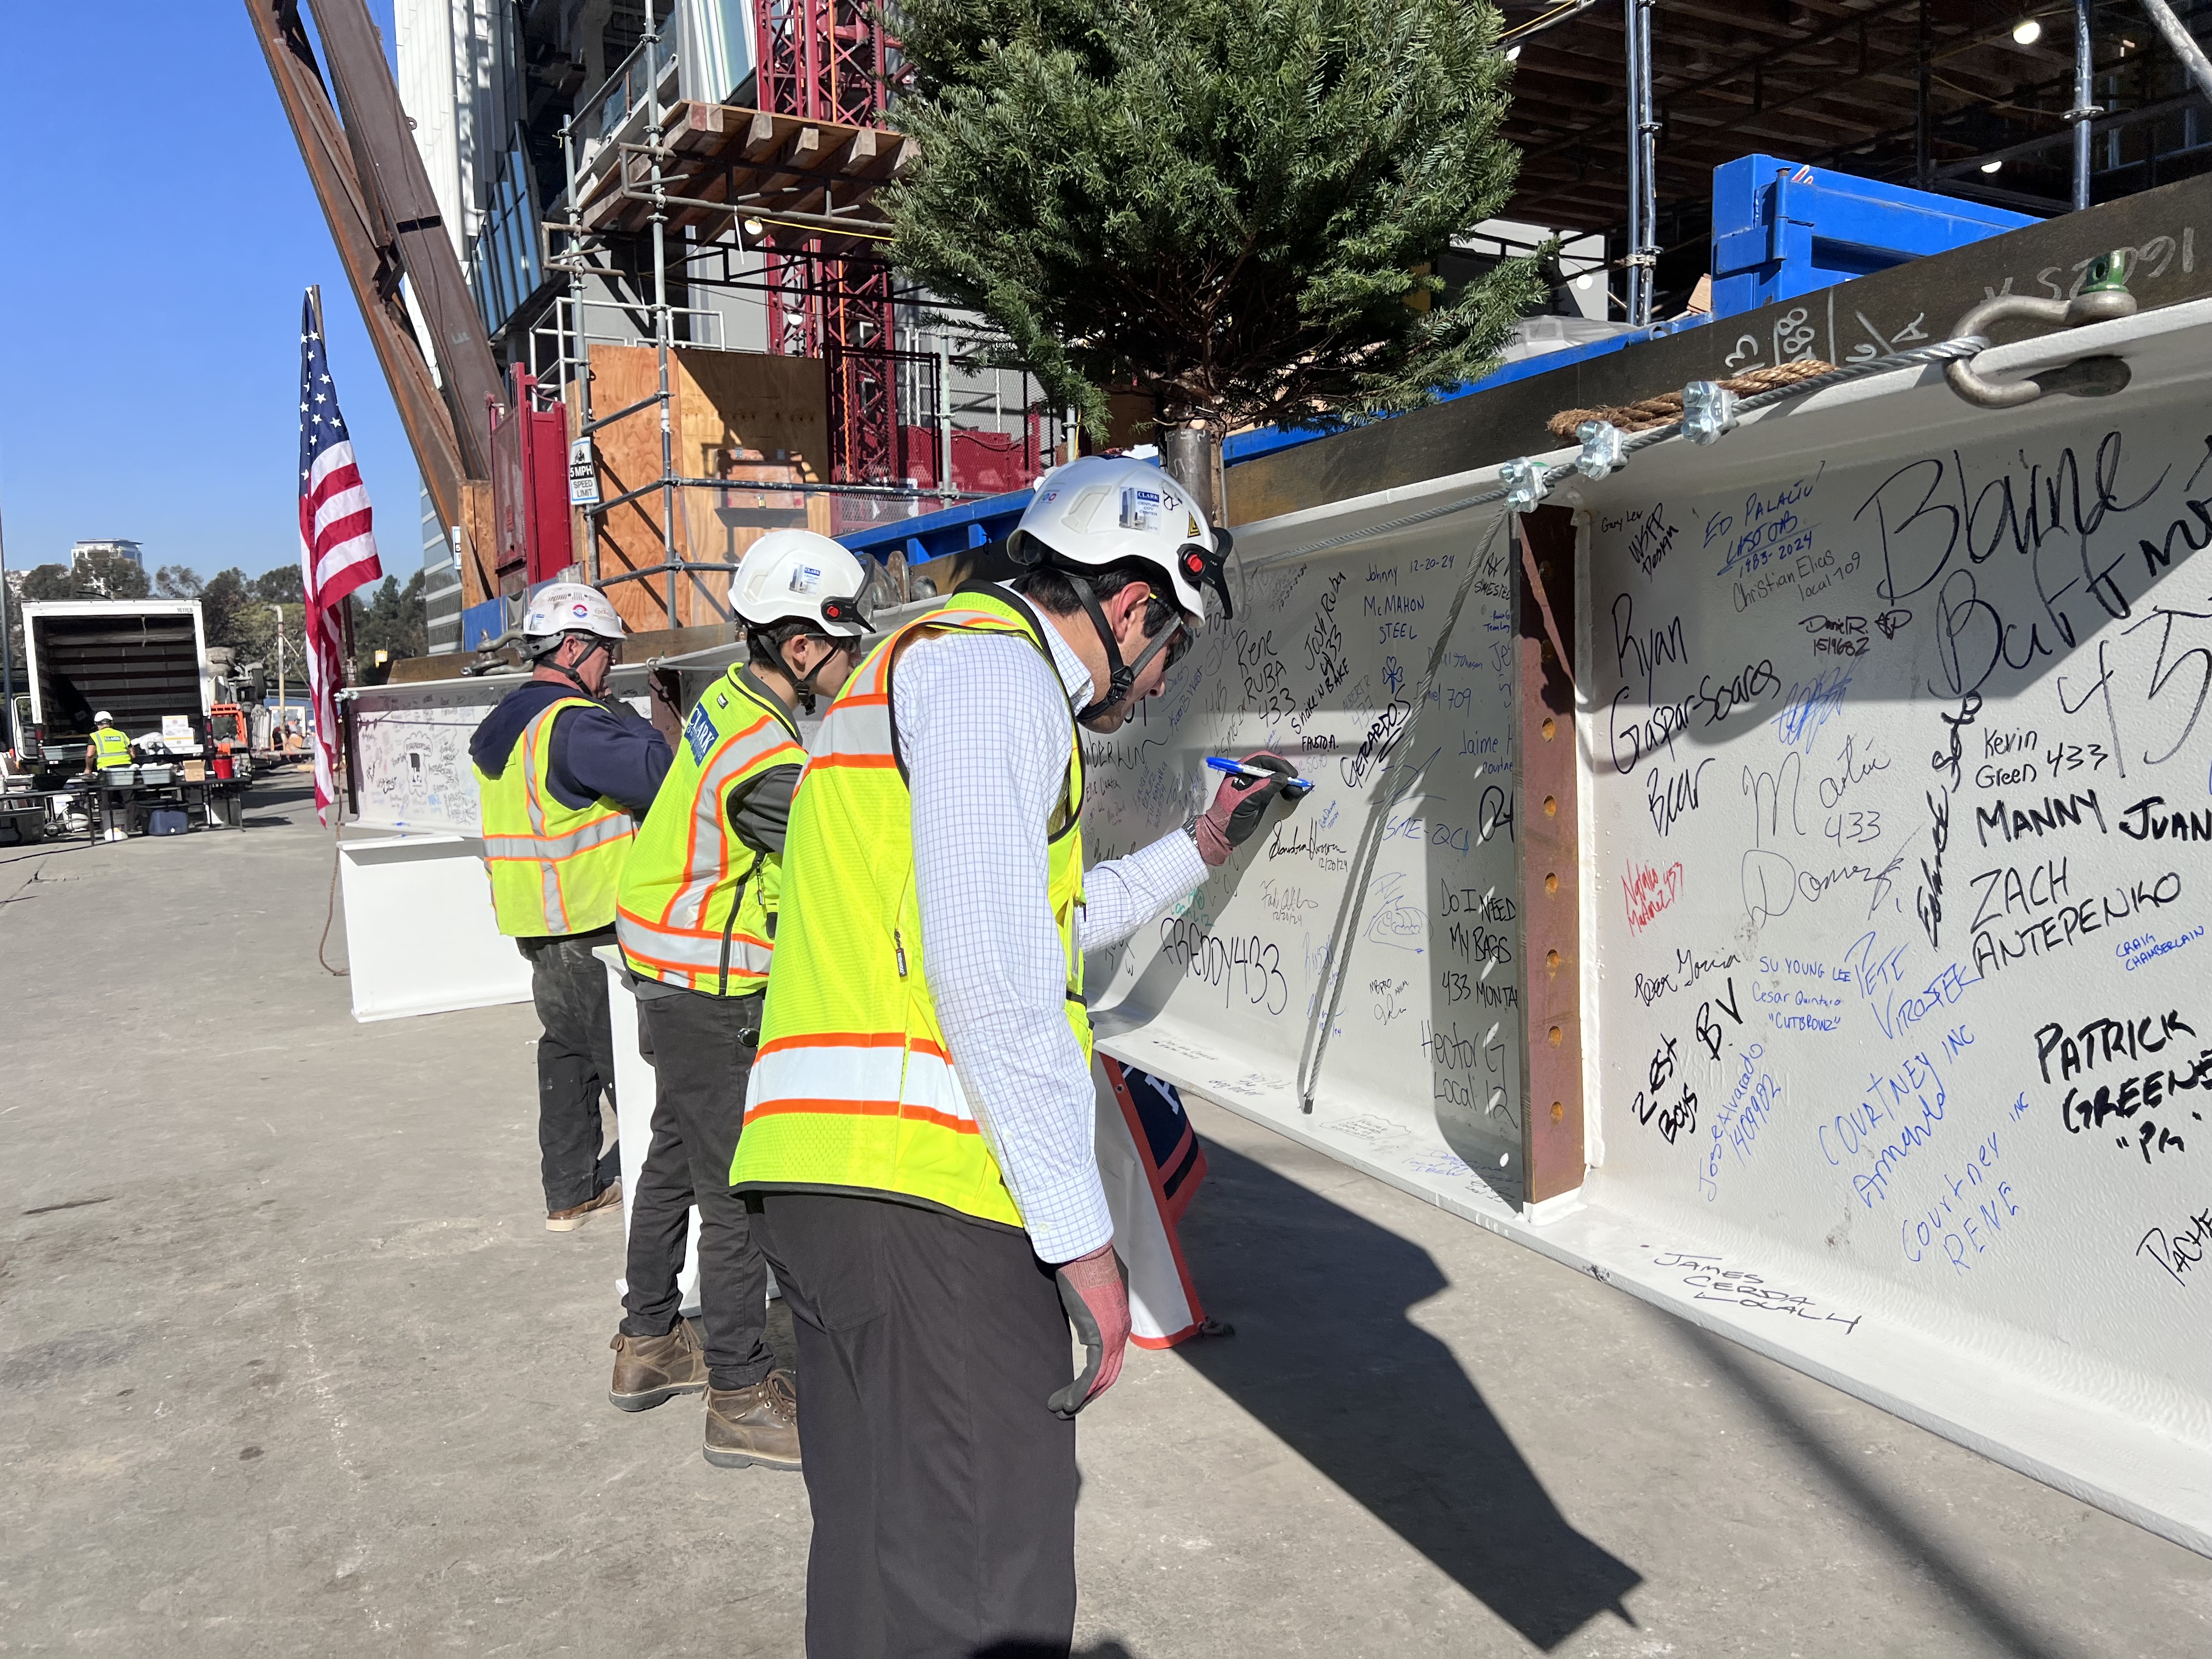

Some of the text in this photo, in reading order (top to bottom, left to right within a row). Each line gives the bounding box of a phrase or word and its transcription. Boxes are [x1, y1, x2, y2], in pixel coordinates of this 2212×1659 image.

[573, 480, 593, 488] SPEED
[577, 488, 592, 498] LIMIT
[1138, 492, 1159, 500] CLARK
[1365, 562, 1398, 586] Johnny
[1379, 622, 1418, 645] STEEL
[1611, 592, 1688, 709] Ryan
[1258, 687, 1296, 729] 433
[1447, 687, 1472, 718] 709
[689, 707, 715, 754] CLARK
[1459, 730, 1499, 756] Jaime
[1984, 727, 2038, 759] Kevin
[1976, 742, 2108, 789] Green 433
[1824, 810, 1881, 848] 433
[1977, 789, 2107, 848] MANNY
[1318, 857, 1348, 872] 12/20/24
[1460, 889, 1476, 913] I
[1479, 894, 1516, 923] NEED
[1970, 855, 2068, 934] ZACH
[1472, 926, 1511, 964] BAGS
[2124, 925, 2205, 971] CHAMBERLAIN
[1759, 956, 1779, 973] SU
[1785, 957, 1825, 978] YOUNG
[1442, 970, 1471, 1006] 433
[1752, 981, 1790, 1003] Cesar
[1421, 1019, 1479, 1070] Hector
[2034, 1009, 2197, 1084] PATRICK
[1434, 1071, 1477, 1112] Local
[1654, 1252, 1764, 1284] JAMES
[1683, 1276, 1816, 1306] CERDA
